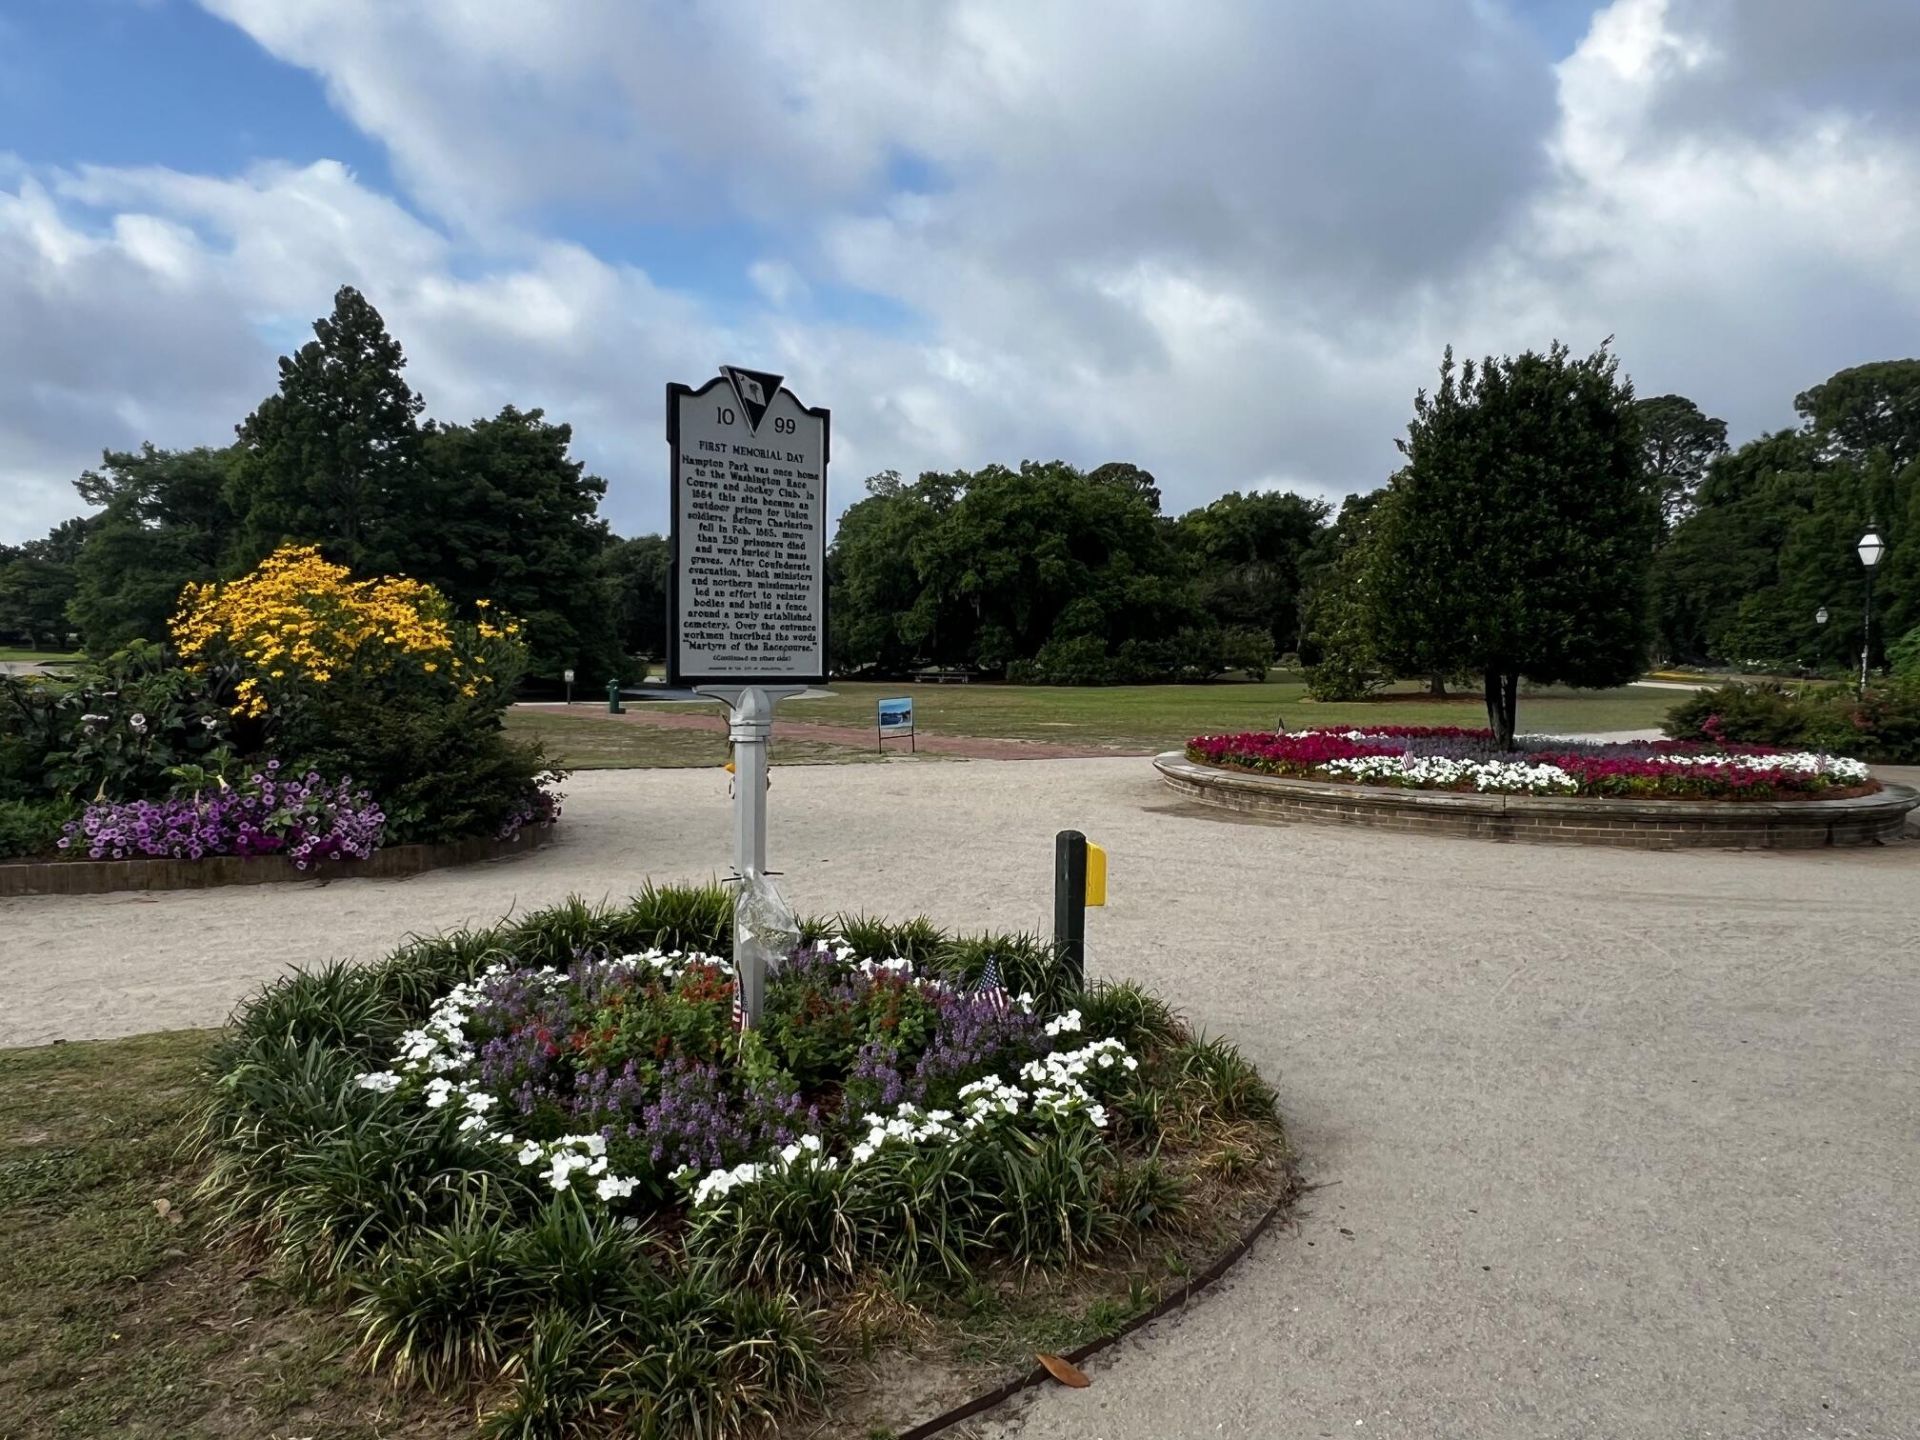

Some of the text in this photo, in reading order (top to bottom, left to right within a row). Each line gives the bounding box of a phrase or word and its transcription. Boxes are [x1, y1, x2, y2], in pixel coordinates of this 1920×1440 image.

[717, 407, 735, 425] 10
[775, 417, 796, 434] 99
[699, 441, 804, 463] FIRST MEMORIAL DAY
[682, 455, 724, 468] Hampton
[729, 461, 749, 471] Park
[754, 466, 769, 474] was
[797, 468, 819, 480] home
[711, 470, 725, 479] the
[731, 472, 780, 486] Washington
[787, 478, 807, 488] Race
[687, 478, 718, 488] Course
[723, 481, 739, 491] and
[744, 483, 774, 496] Jockey
[779, 486, 800, 498] Club.
[719, 493, 735, 502] this
[741, 496, 758, 504] site
[763, 497, 794, 508] became
[692, 501, 808, 519] outdoor prison for Union
[688, 512, 813, 530] soldiers. Before Charleston
[699, 523, 714, 531] fell
[732, 528, 751, 536] Feb.
[698, 534, 805, 550] than 250 prisoners died
[695, 545, 712, 553] and
[742, 548, 770, 558] buried
[775, 551, 782, 559] in
[691, 557, 810, 571] graves. After Confederate
[688, 566, 812, 581] evacuation, black ministers
[691, 577, 810, 591] and northern missionaries
[695, 588, 709, 596] led
[729, 590, 757, 598] effort
[763, 592, 772, 600] to
[776, 592, 806, 601] reinter
[693, 598, 725, 608] bodies
[729, 600, 744, 608] and
[749, 600, 772, 609] build
[786, 602, 807, 611] fence
[688, 610, 720, 618] around
[734, 610, 759, 620] newly
[764, 611, 812, 621] established
[683, 621, 730, 630] cemetery.
[735, 621, 757, 630] Over
[761, 622, 775, 630] the
[683, 631, 816, 642] workmen inscribed the words
[731, 641, 740, 650] of
[745, 642, 758, 650] the
